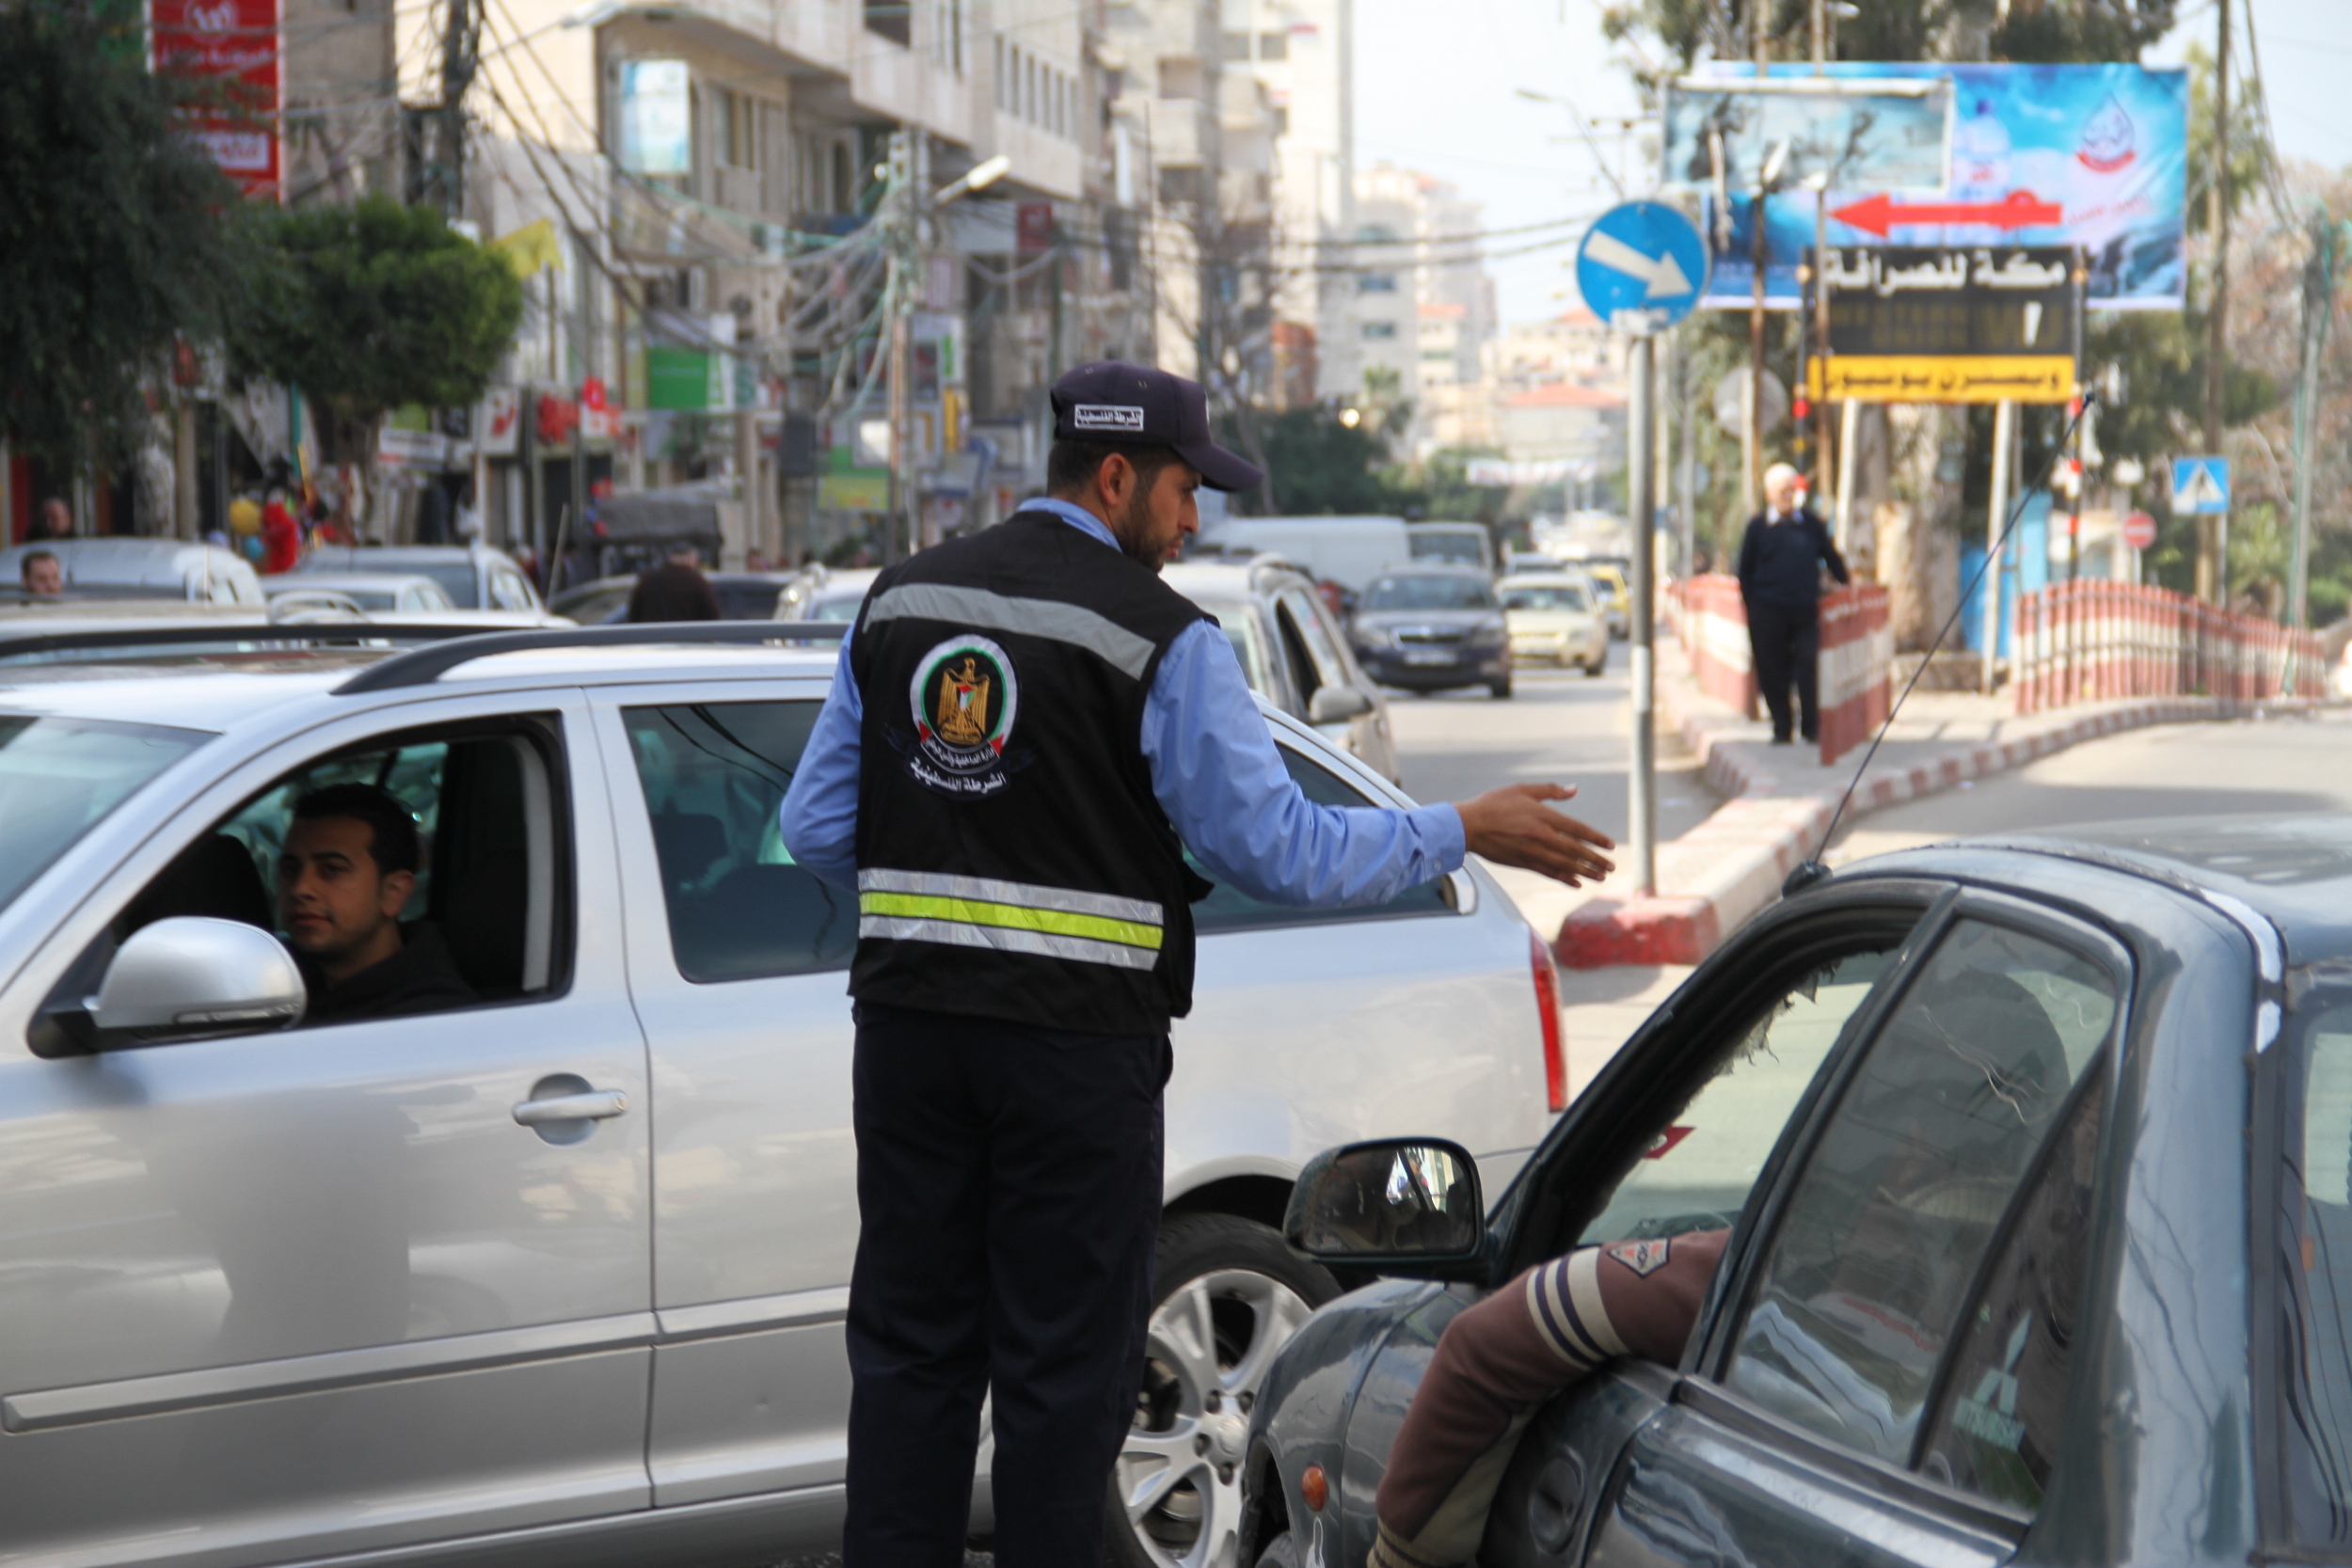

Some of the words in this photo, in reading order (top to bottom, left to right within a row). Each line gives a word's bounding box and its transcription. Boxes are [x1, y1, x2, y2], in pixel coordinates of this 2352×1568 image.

[1824, 246, 1968, 298] للصرافة
[1973, 247, 2067, 289] مكة
[909, 755, 963, 792] الفلسطينية
[962, 770, 1008, 794] الشرطة
